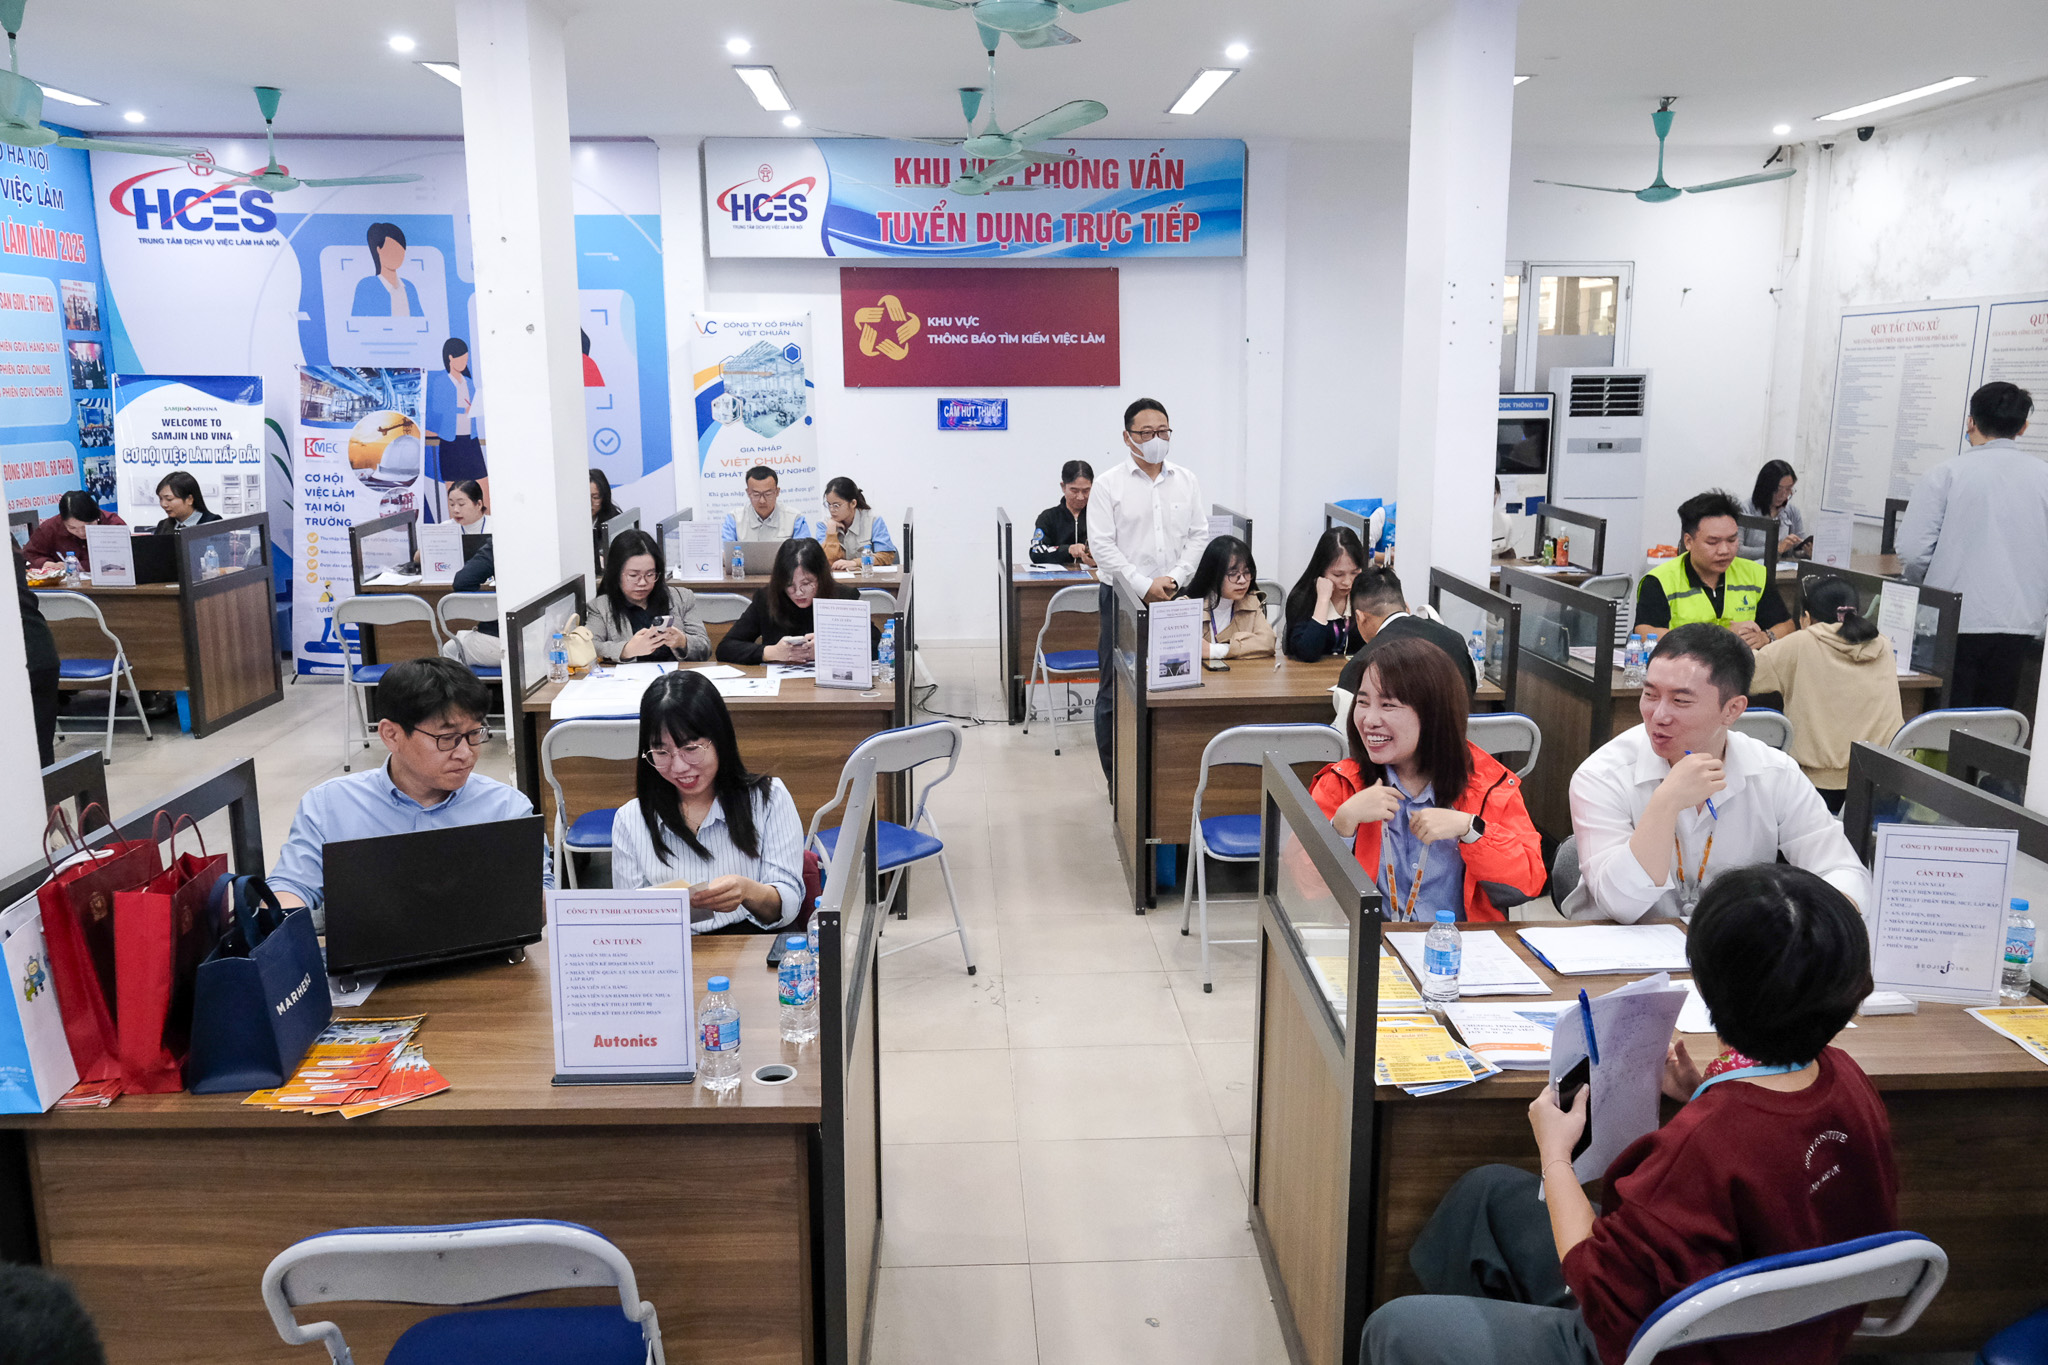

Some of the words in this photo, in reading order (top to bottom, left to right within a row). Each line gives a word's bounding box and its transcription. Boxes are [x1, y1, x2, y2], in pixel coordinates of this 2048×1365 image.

[28, 147, 50, 174] NỘI
[893, 157, 950, 189] KHU
[1024, 148, 1118, 189] PHỎNG
[1129, 147, 1184, 189] VẤN
[36, 181, 64, 211] LÀM
[133, 188, 277, 233] HCES
[731, 193, 808, 222] HCES
[877, 199, 966, 243] TUYỂN
[976, 211, 1052, 250] DỤNG
[1061, 209, 1132, 250] TRỰC
[1141, 202, 1200, 243] TIẾP
[1, 216, 29, 255] LÀM
[29, 221, 58, 259] NĂM
[59, 231, 86, 264] 2025
[184, 238, 202, 246] DỊCH
[216, 238, 234, 246] VIỆC
[266, 238, 280, 247] NỘI
[37, 292, 54, 312] PHIÊN
[928, 317, 952, 326] KHU
[954, 315, 980, 328] VỰC
[2030, 313, 2048, 327] QU
[1870, 324, 1888, 335] QUY
[927, 332, 968, 344] THÔNG
[971, 332, 996, 344] BÁO
[998, 332, 1018, 344] TÌM
[1021, 331, 1049, 344] KIẾM
[1052, 332, 1078, 345] VIỆC
[1080, 332, 1105, 344] LÀM
[32, 365, 50, 374] ONLINE
[944, 402, 960, 417] CẤM
[961, 403, 976, 417] HÚT
[162, 419, 208, 427] WELCOME
[210, 419, 222, 427] TO
[152, 432, 188, 440] SAMJIN
[123, 447, 140, 464] CƠ
[141, 446, 160, 466] HỘI
[162, 446, 187, 466] VIỆC
[189, 446, 212, 464] LÀM
[215, 444, 237, 464] HẤP
[239, 444, 260, 464] DẪN
[720, 456, 750, 468] VIỆT
[754, 454, 802, 466] CHUẨN
[58, 456, 74, 476] PHIÊN
[305, 474, 321, 482] CƠ
[323, 472, 343, 485] HỘI
[305, 487, 329, 499] VIỆC
[332, 488, 355, 497] LÀM
[8, 499, 15, 510] 63
[305, 503, 321, 513] TẠI
[325, 502, 345, 512] MÔI
[594, 1034, 658, 1047] Autonics
